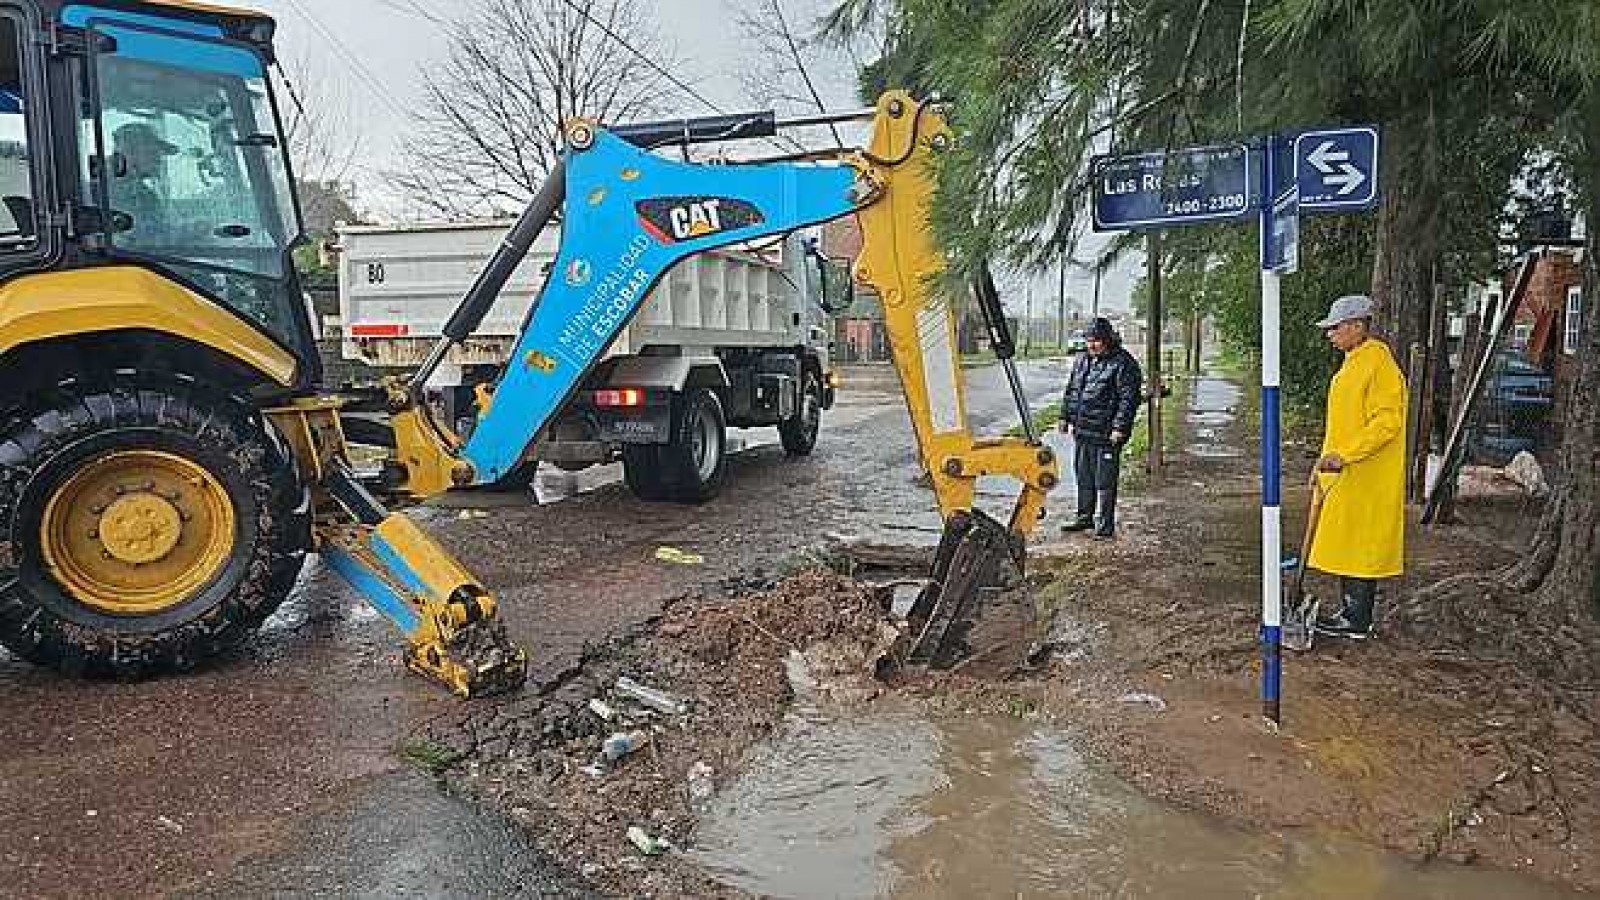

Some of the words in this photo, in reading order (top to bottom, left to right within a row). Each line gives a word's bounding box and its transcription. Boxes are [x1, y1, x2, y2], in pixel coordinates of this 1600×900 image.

[670, 199, 721, 239] CAT
[558, 234, 650, 346] MUNICIPALIDAD
[573, 334, 592, 360] DE
[592, 268, 649, 337] ESCOBAR
